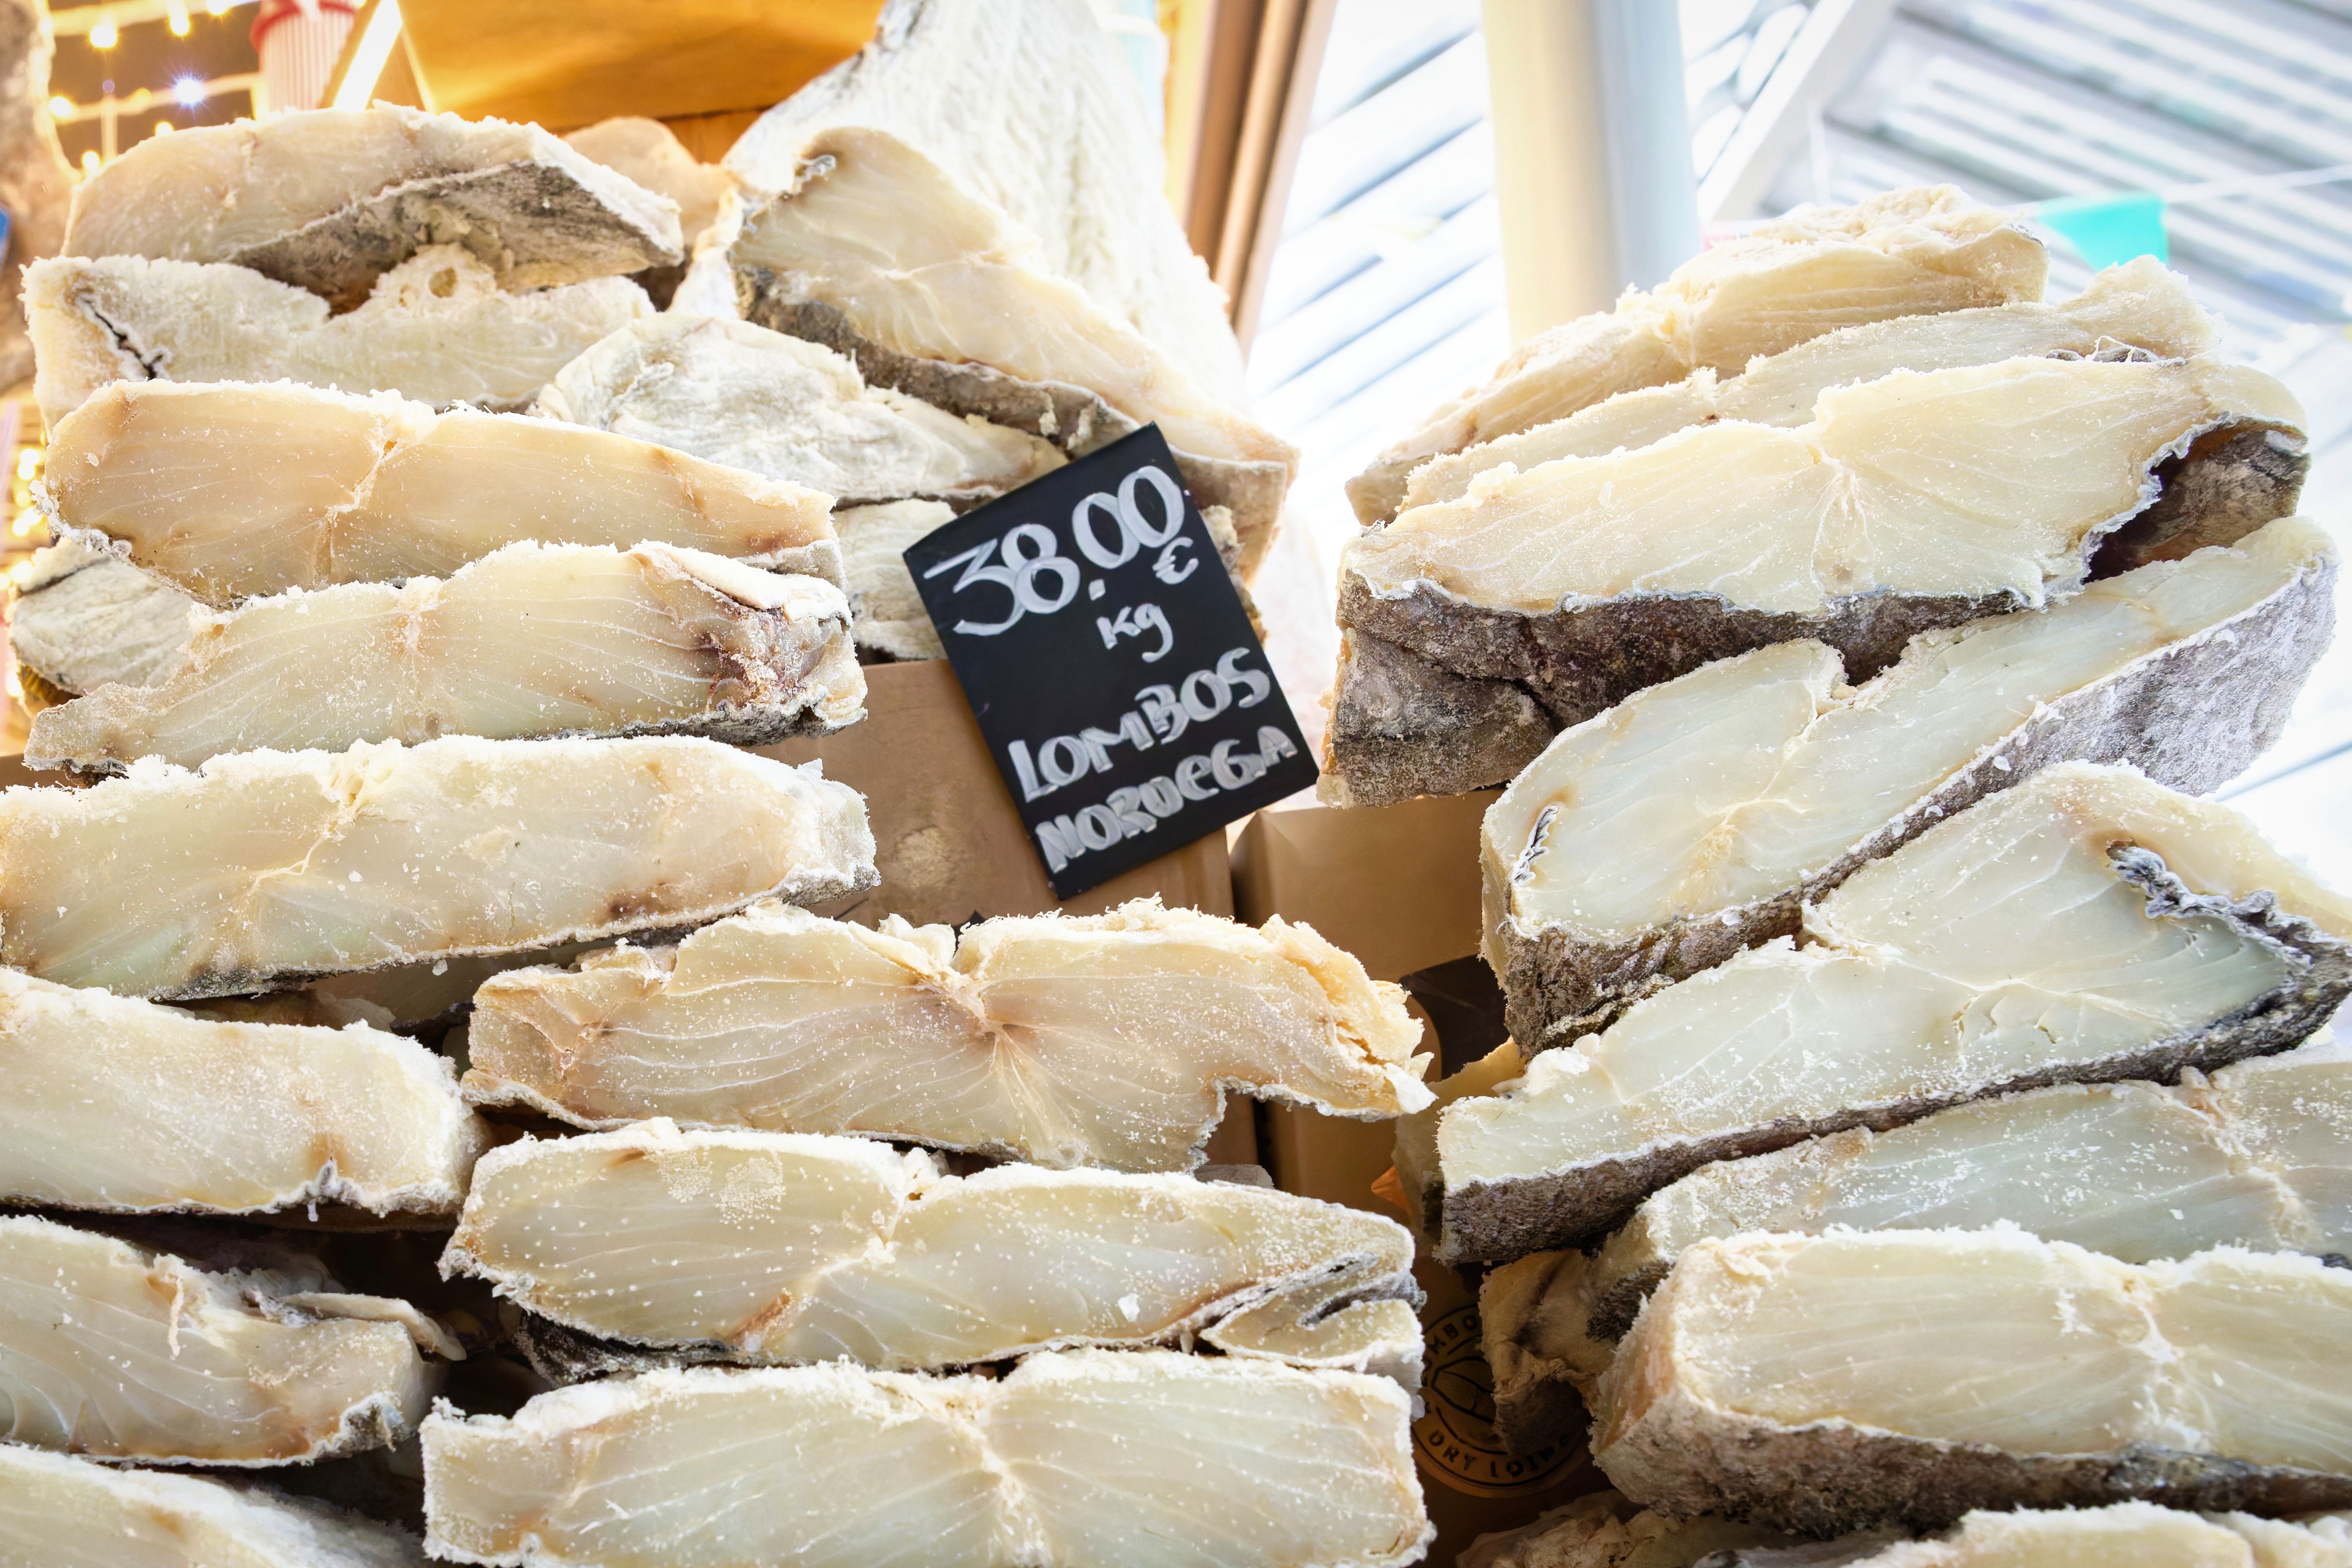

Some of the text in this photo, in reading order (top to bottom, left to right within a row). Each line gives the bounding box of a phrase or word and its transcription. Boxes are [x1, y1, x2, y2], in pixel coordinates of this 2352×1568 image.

[1152, 536, 1199, 584] €
[1008, 646, 1270, 802] LOMBOS
[1428, 1429, 1477, 1470] DRY
